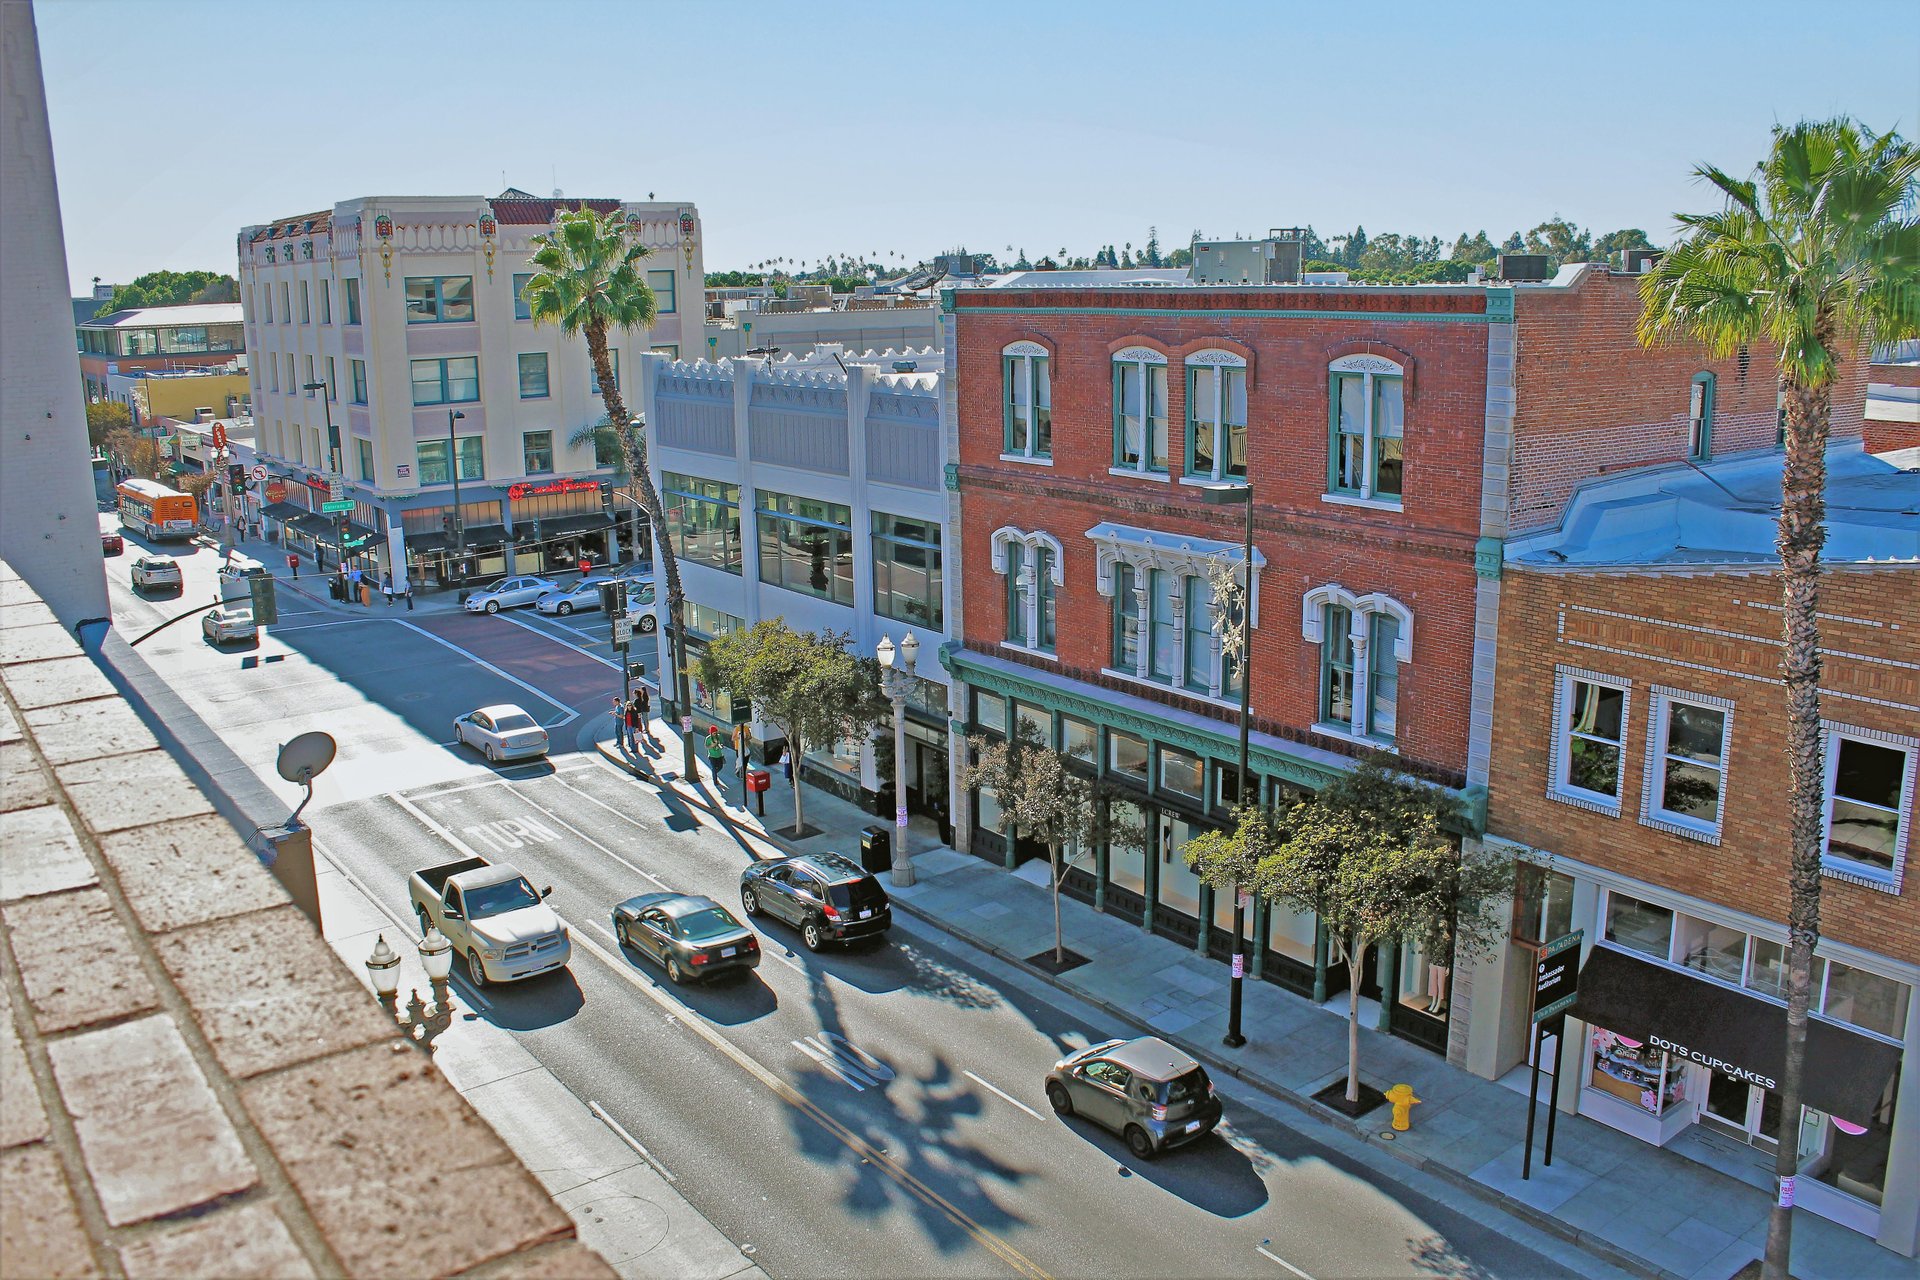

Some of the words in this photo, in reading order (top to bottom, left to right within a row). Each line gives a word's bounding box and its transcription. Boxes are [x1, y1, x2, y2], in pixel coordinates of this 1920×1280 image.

[616, 628, 631, 636] BLOCK
[462, 815, 563, 853] TURN
[1547, 934, 1581, 955] PASADENA
[1537, 975, 1562, 992] Auditorium
[1538, 964, 1565, 983] Ambassador
[1649, 1034, 1689, 1057] DOTS
[1691, 1051, 1776, 1089] CUPCAKES
